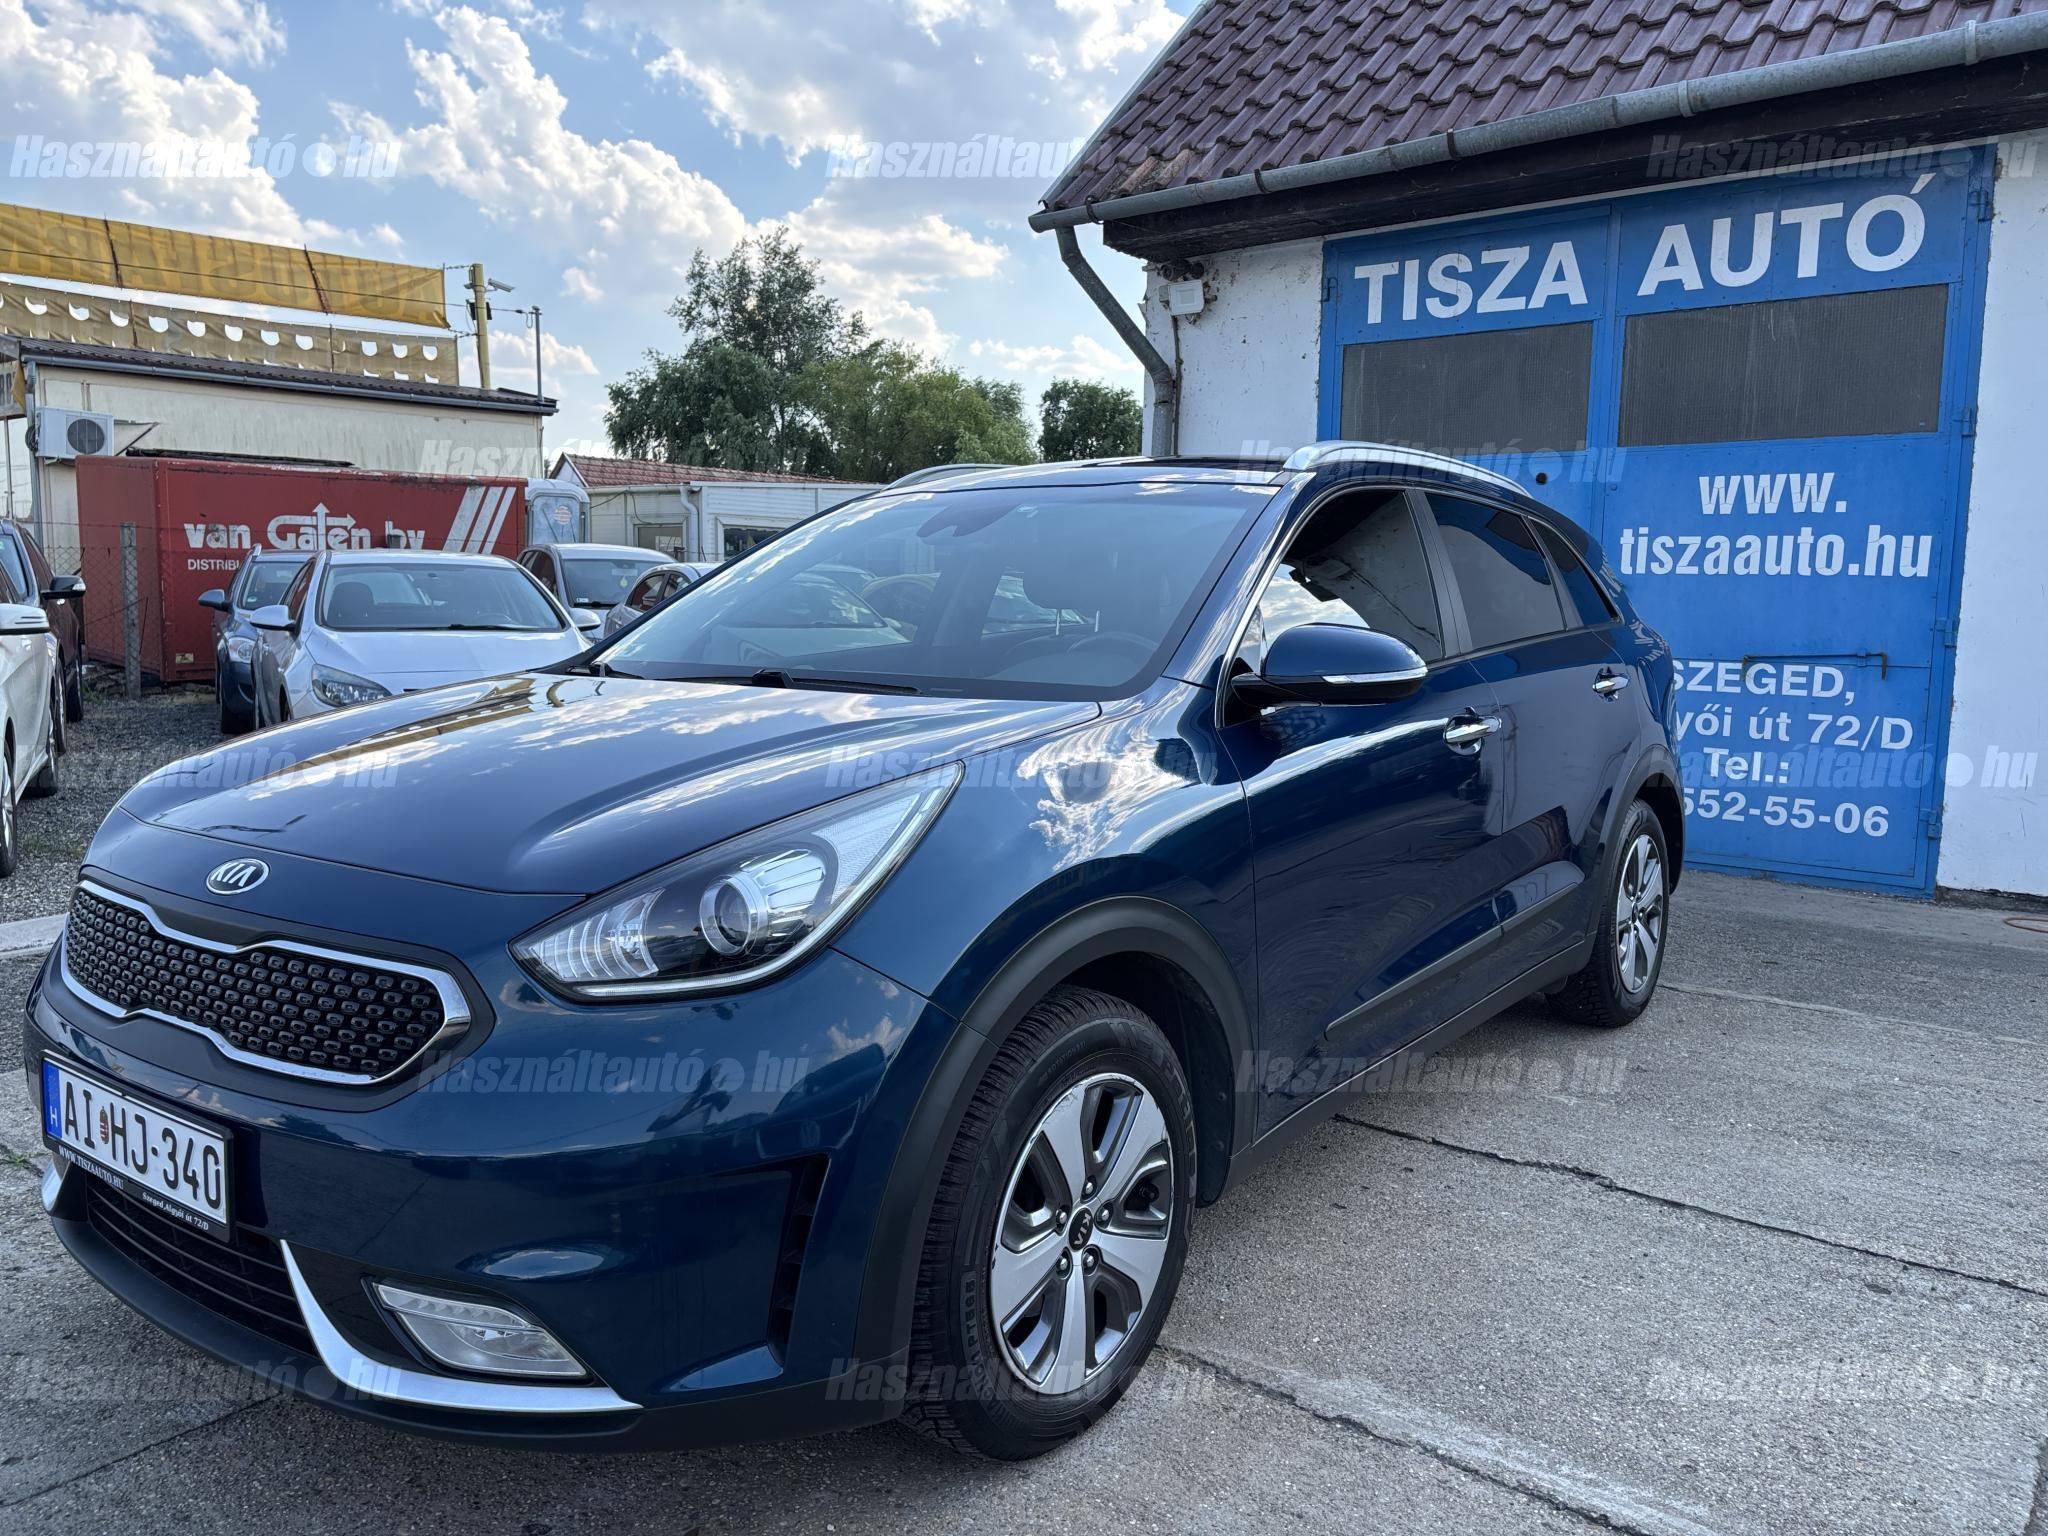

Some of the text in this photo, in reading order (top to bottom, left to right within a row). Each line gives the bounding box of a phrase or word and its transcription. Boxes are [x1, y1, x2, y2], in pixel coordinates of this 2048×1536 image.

[1354, 173, 1936, 324] TISZA AUTÓ
[1699, 472, 1847, 515] www.
[184, 523, 251, 549] van
[1620, 525, 1932, 577] tiszaauto.hu
[1749, 707, 1792, 741] út
[1808, 714, 1913, 751] 72/D
[1703, 747, 1789, 784] Tel.:
[210, 862, 257, 887] KIA
[49, 1106, 58, 1127] H
[58, 1144, 125, 1190] WWW.TISZAAUTO.HU
[1073, 1212, 1091, 1245] KIA
